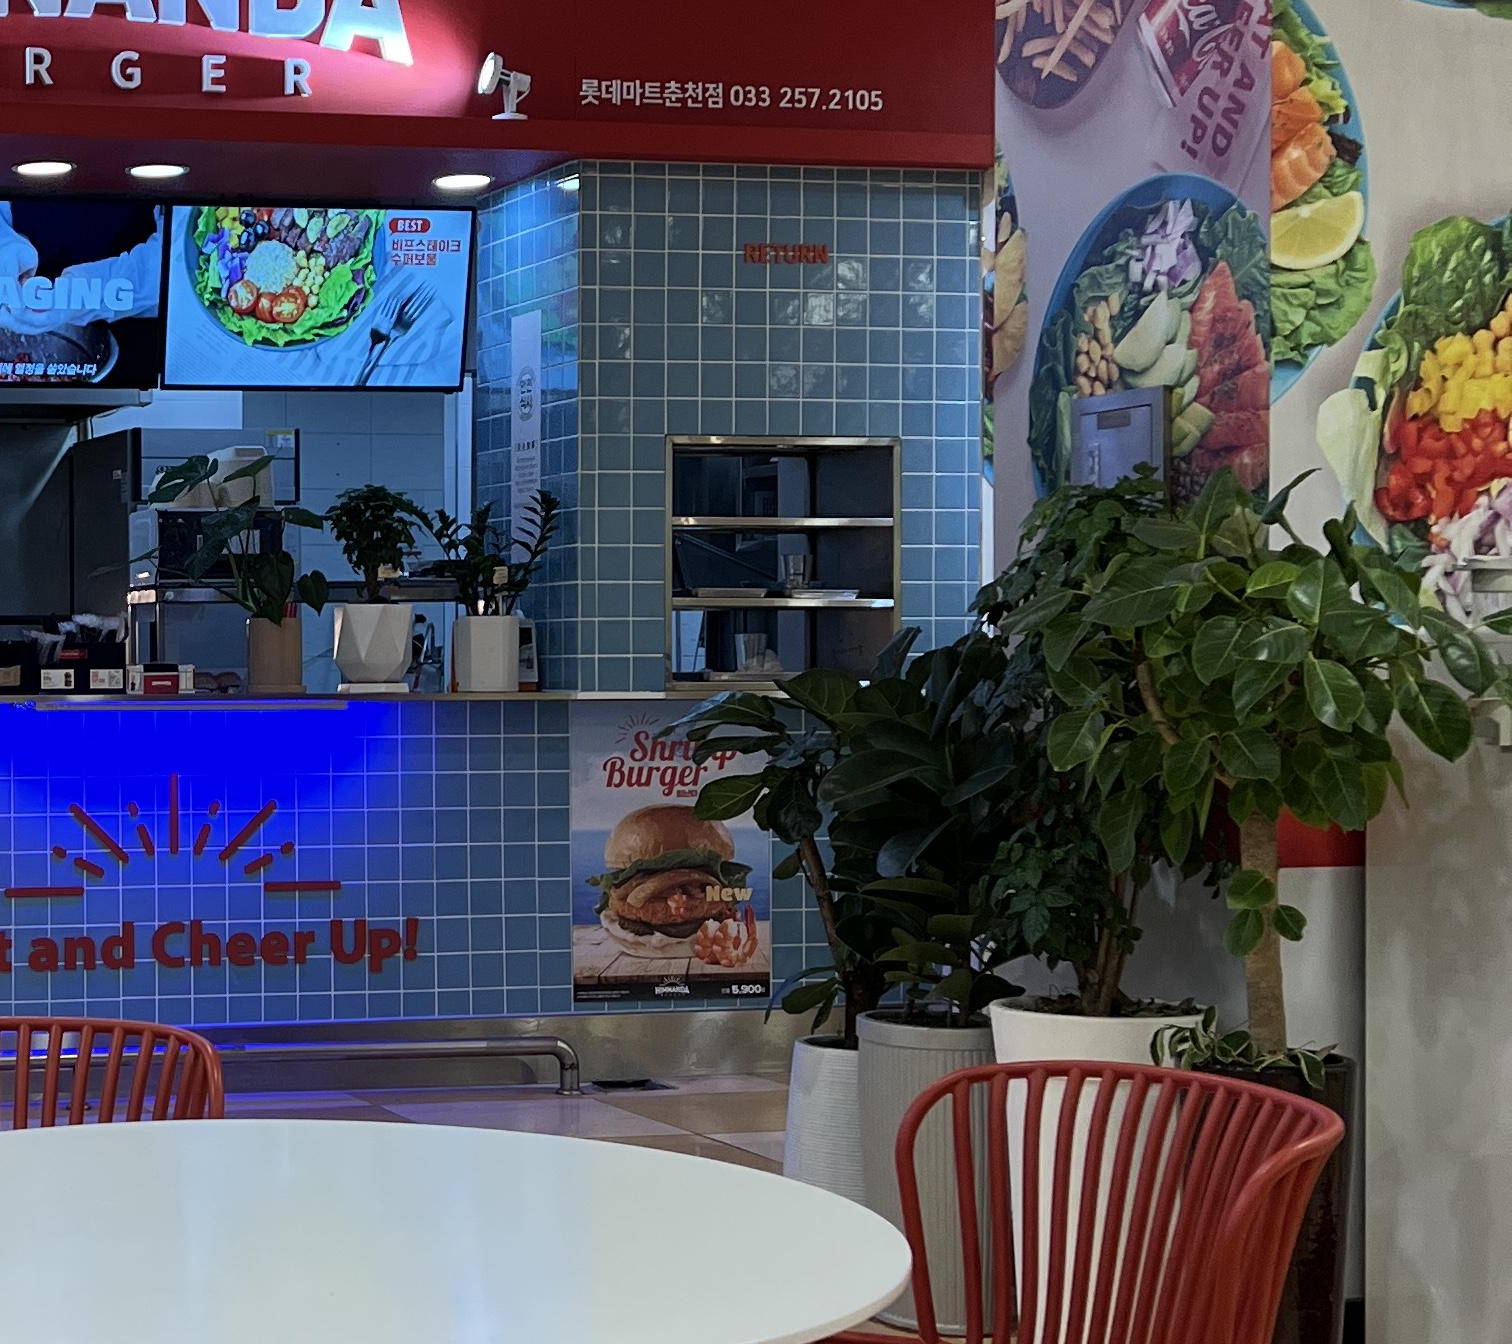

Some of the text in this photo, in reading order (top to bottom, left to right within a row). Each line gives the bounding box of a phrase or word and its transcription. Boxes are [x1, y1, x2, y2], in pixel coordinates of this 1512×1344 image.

[579, 78, 884, 111] 롯데마트춘천점 033 257.2105
[1211, 59, 1256, 157] AND
[1180, 86, 1221, 161] UP!
[397, 220, 423, 232] BEST
[392, 239, 461, 253] 비프스테이크
[743, 243, 829, 264] RETURN
[603, 756, 708, 797] Burger
[705, 885, 754, 902] New
[28, 921, 135, 972] and
[152, 920, 316, 968] Cheer
[330, 918, 419, 973] Up!
